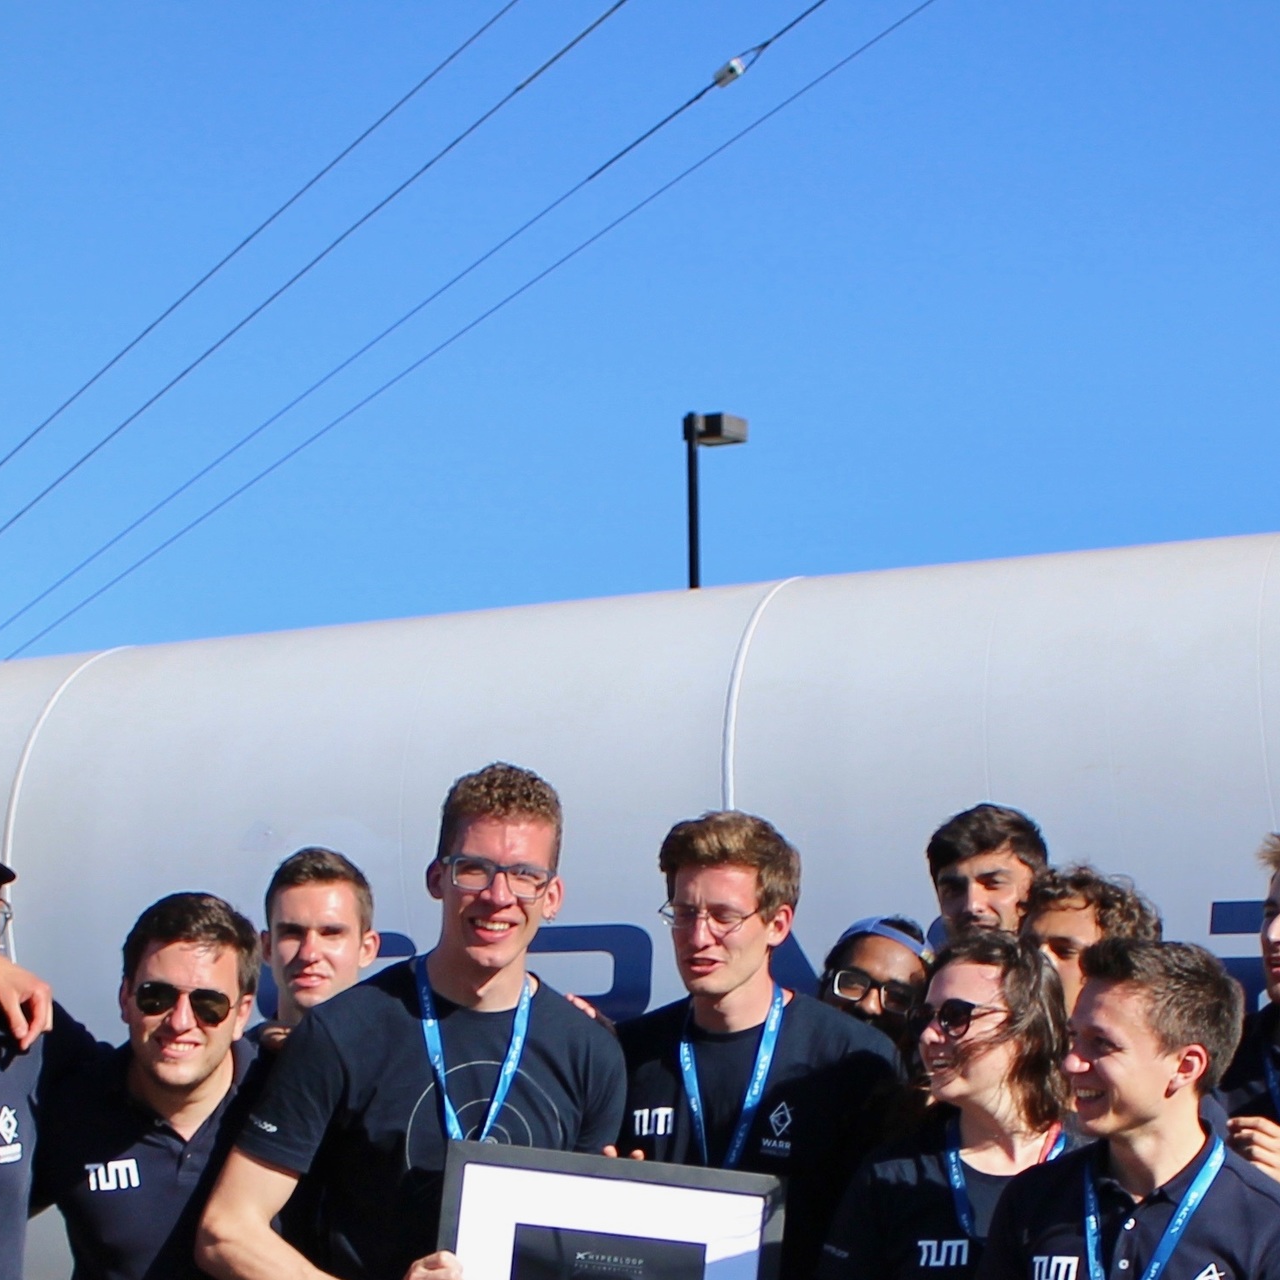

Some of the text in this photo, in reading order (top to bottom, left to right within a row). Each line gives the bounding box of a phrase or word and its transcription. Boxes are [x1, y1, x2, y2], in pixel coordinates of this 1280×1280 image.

[633, 1107, 674, 1136] TUM
[761, 1137, 791, 1150] WARR
[85, 1158, 140, 1191] TUM
[1170, 1192, 1199, 1234] SPACEX
[588, 1254, 644, 1265] HYPERLOOP
[917, 1239, 969, 1267] TUM
